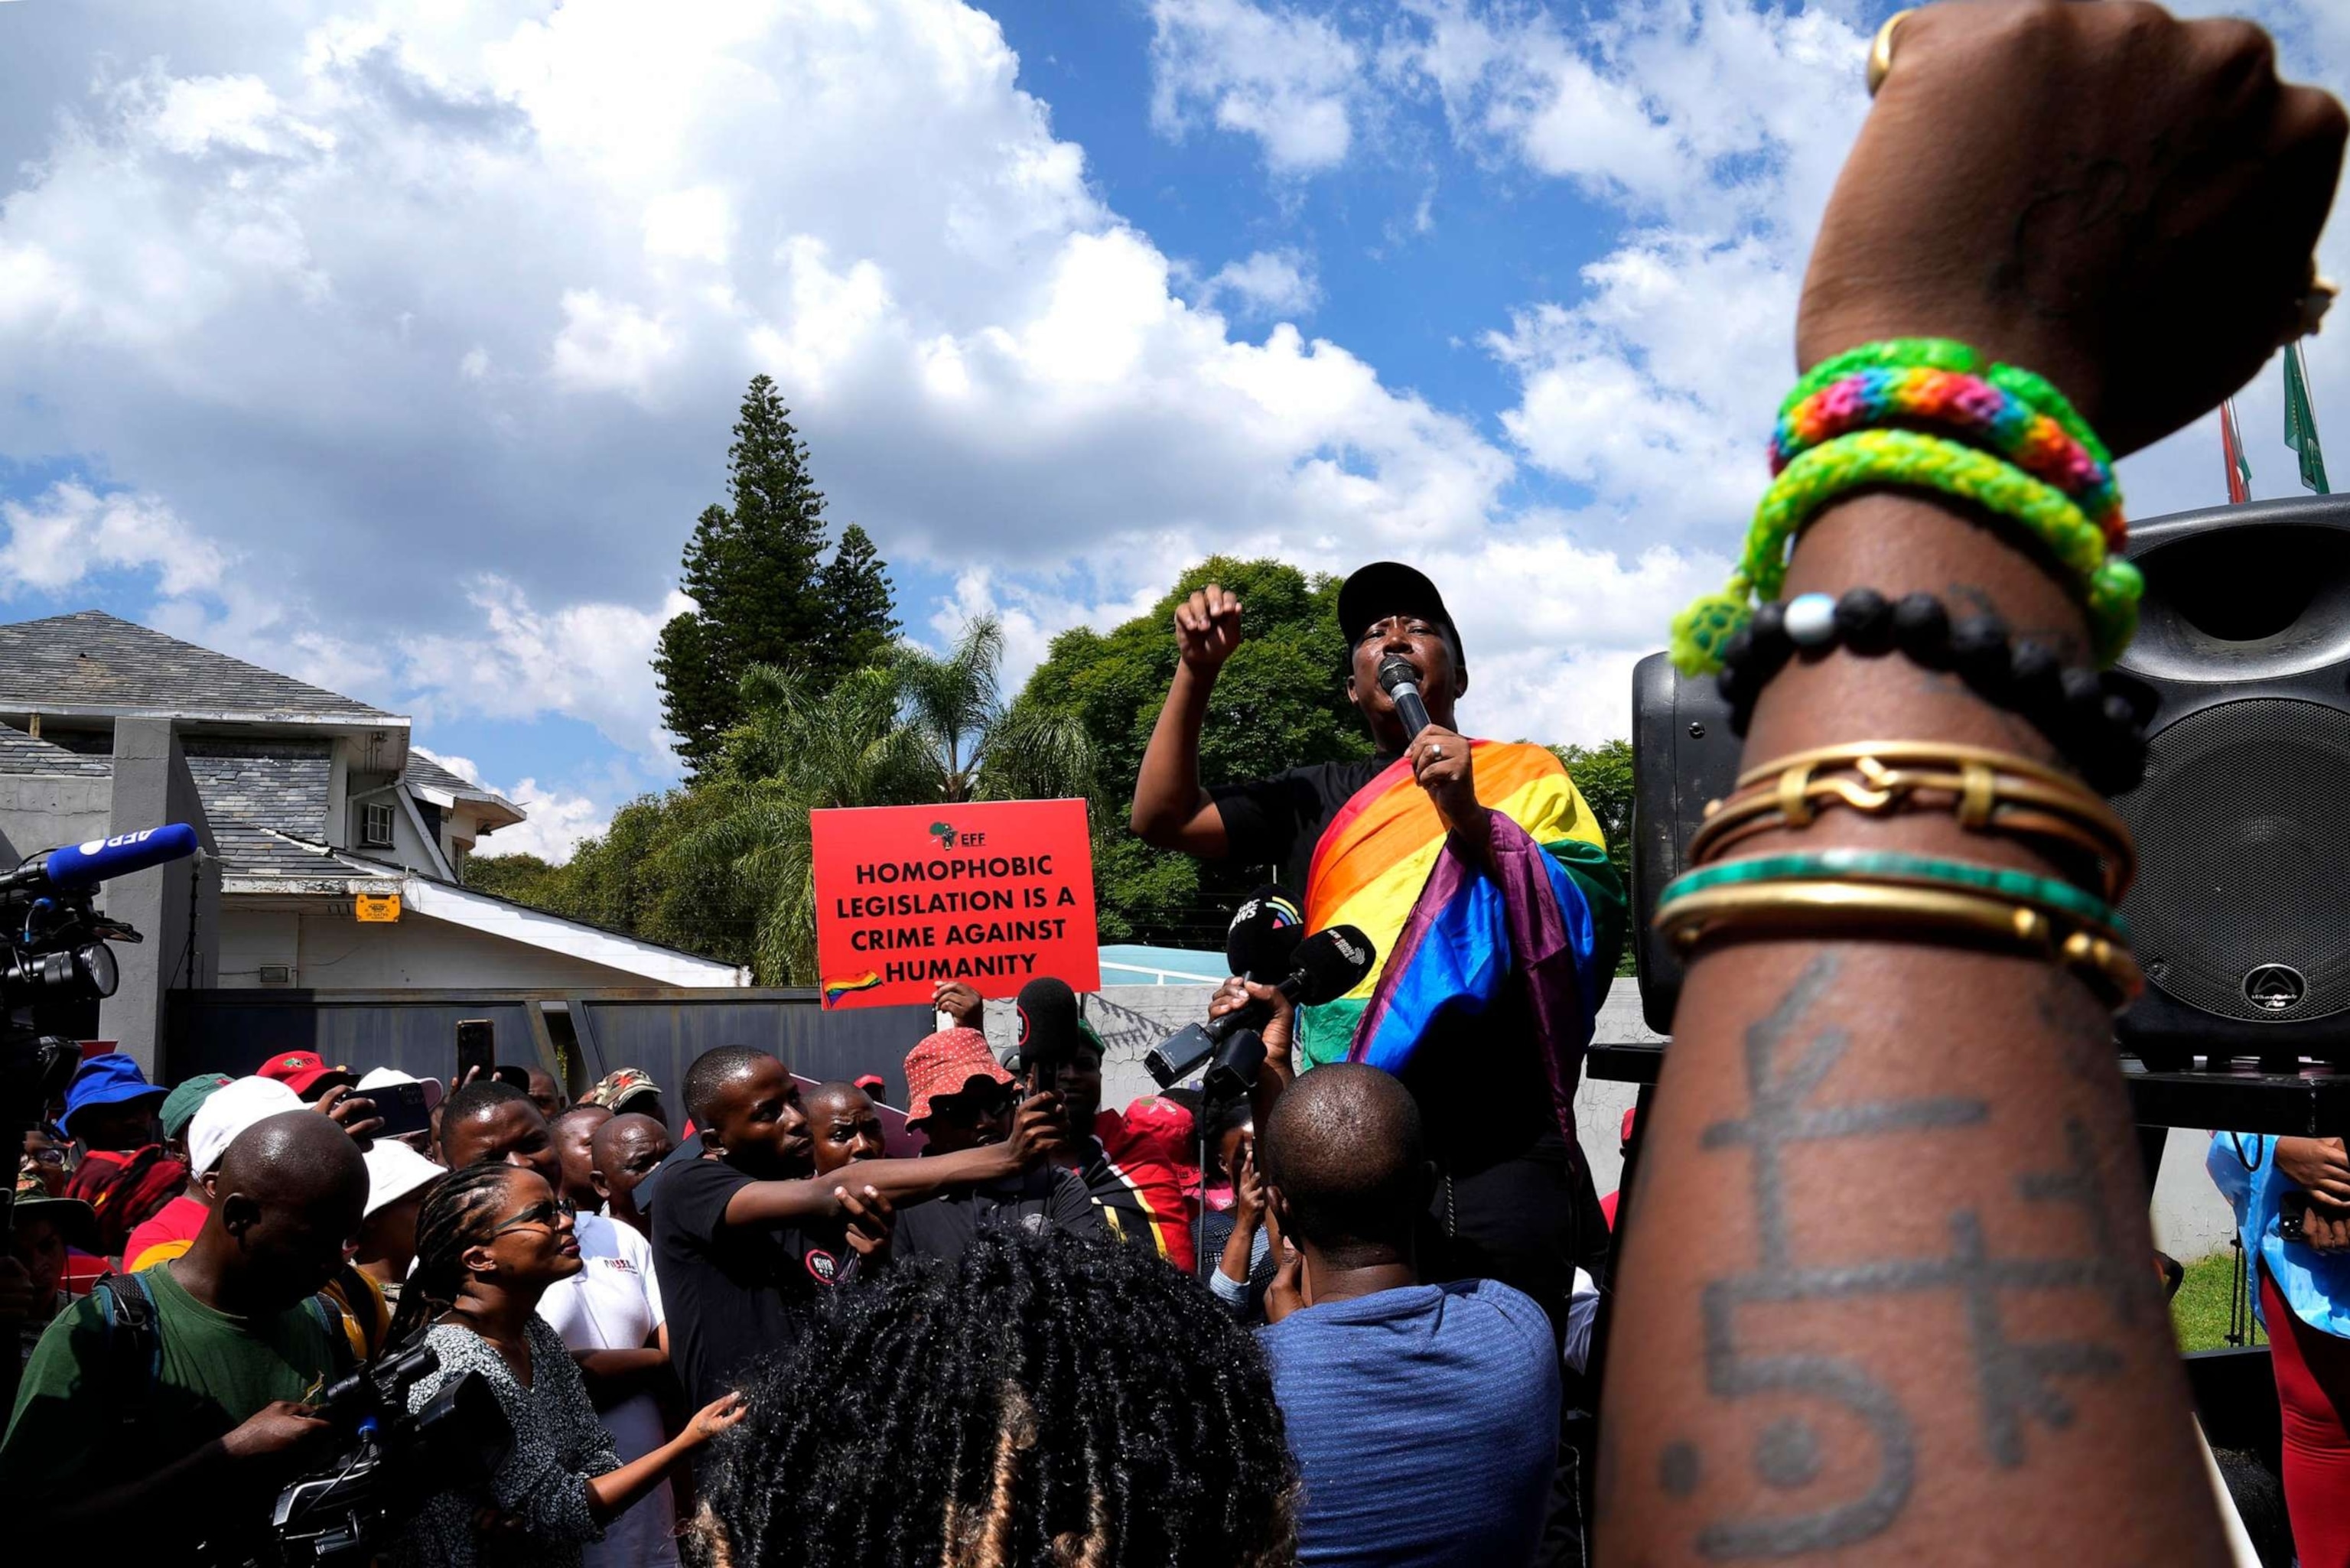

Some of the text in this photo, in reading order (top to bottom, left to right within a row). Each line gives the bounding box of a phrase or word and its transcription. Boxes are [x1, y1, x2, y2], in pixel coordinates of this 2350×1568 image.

[961, 833, 985, 845] EFF
[856, 854, 1053, 885] HOMOPHOBIC
[837, 886, 1076, 919] LEGISLATION IS A
[851, 919, 1066, 952] CRIME AGAINST
[885, 953, 1037, 984] HUMANITY
